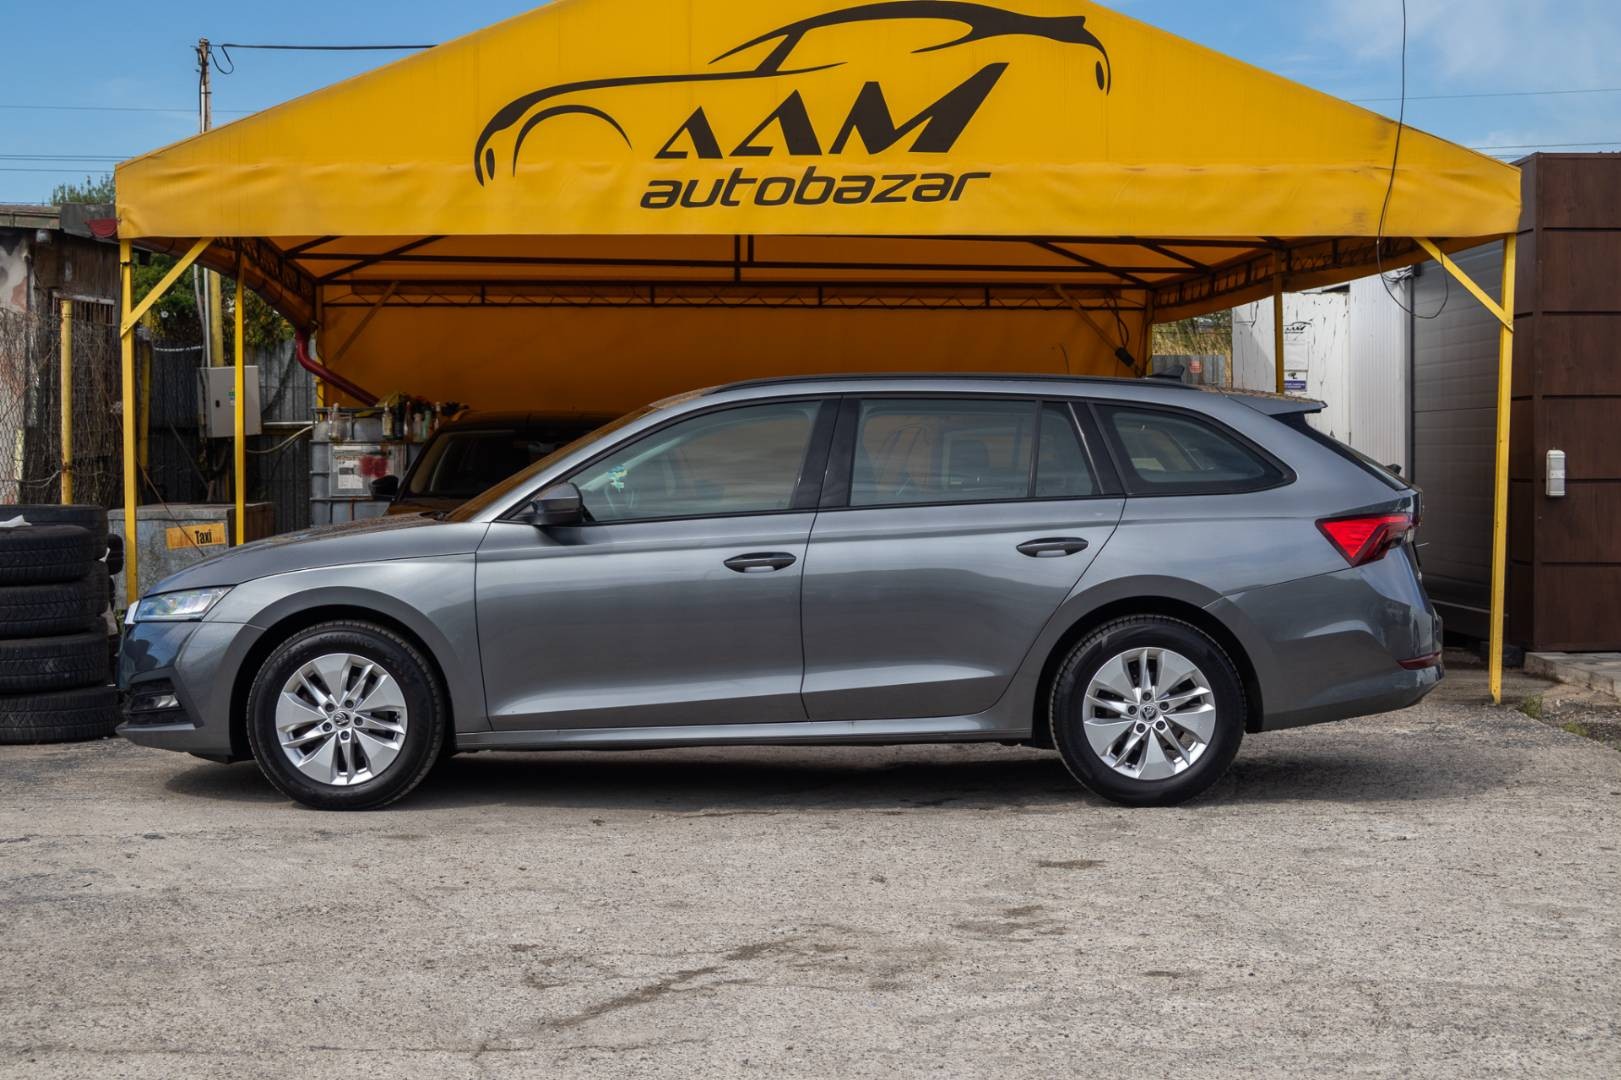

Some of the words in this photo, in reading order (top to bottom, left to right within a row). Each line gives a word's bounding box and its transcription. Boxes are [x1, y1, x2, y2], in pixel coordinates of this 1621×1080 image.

[654, 62, 1009, 159] AAM
[640, 165, 991, 209] autobazar
[194, 528, 212, 545] Taxi
